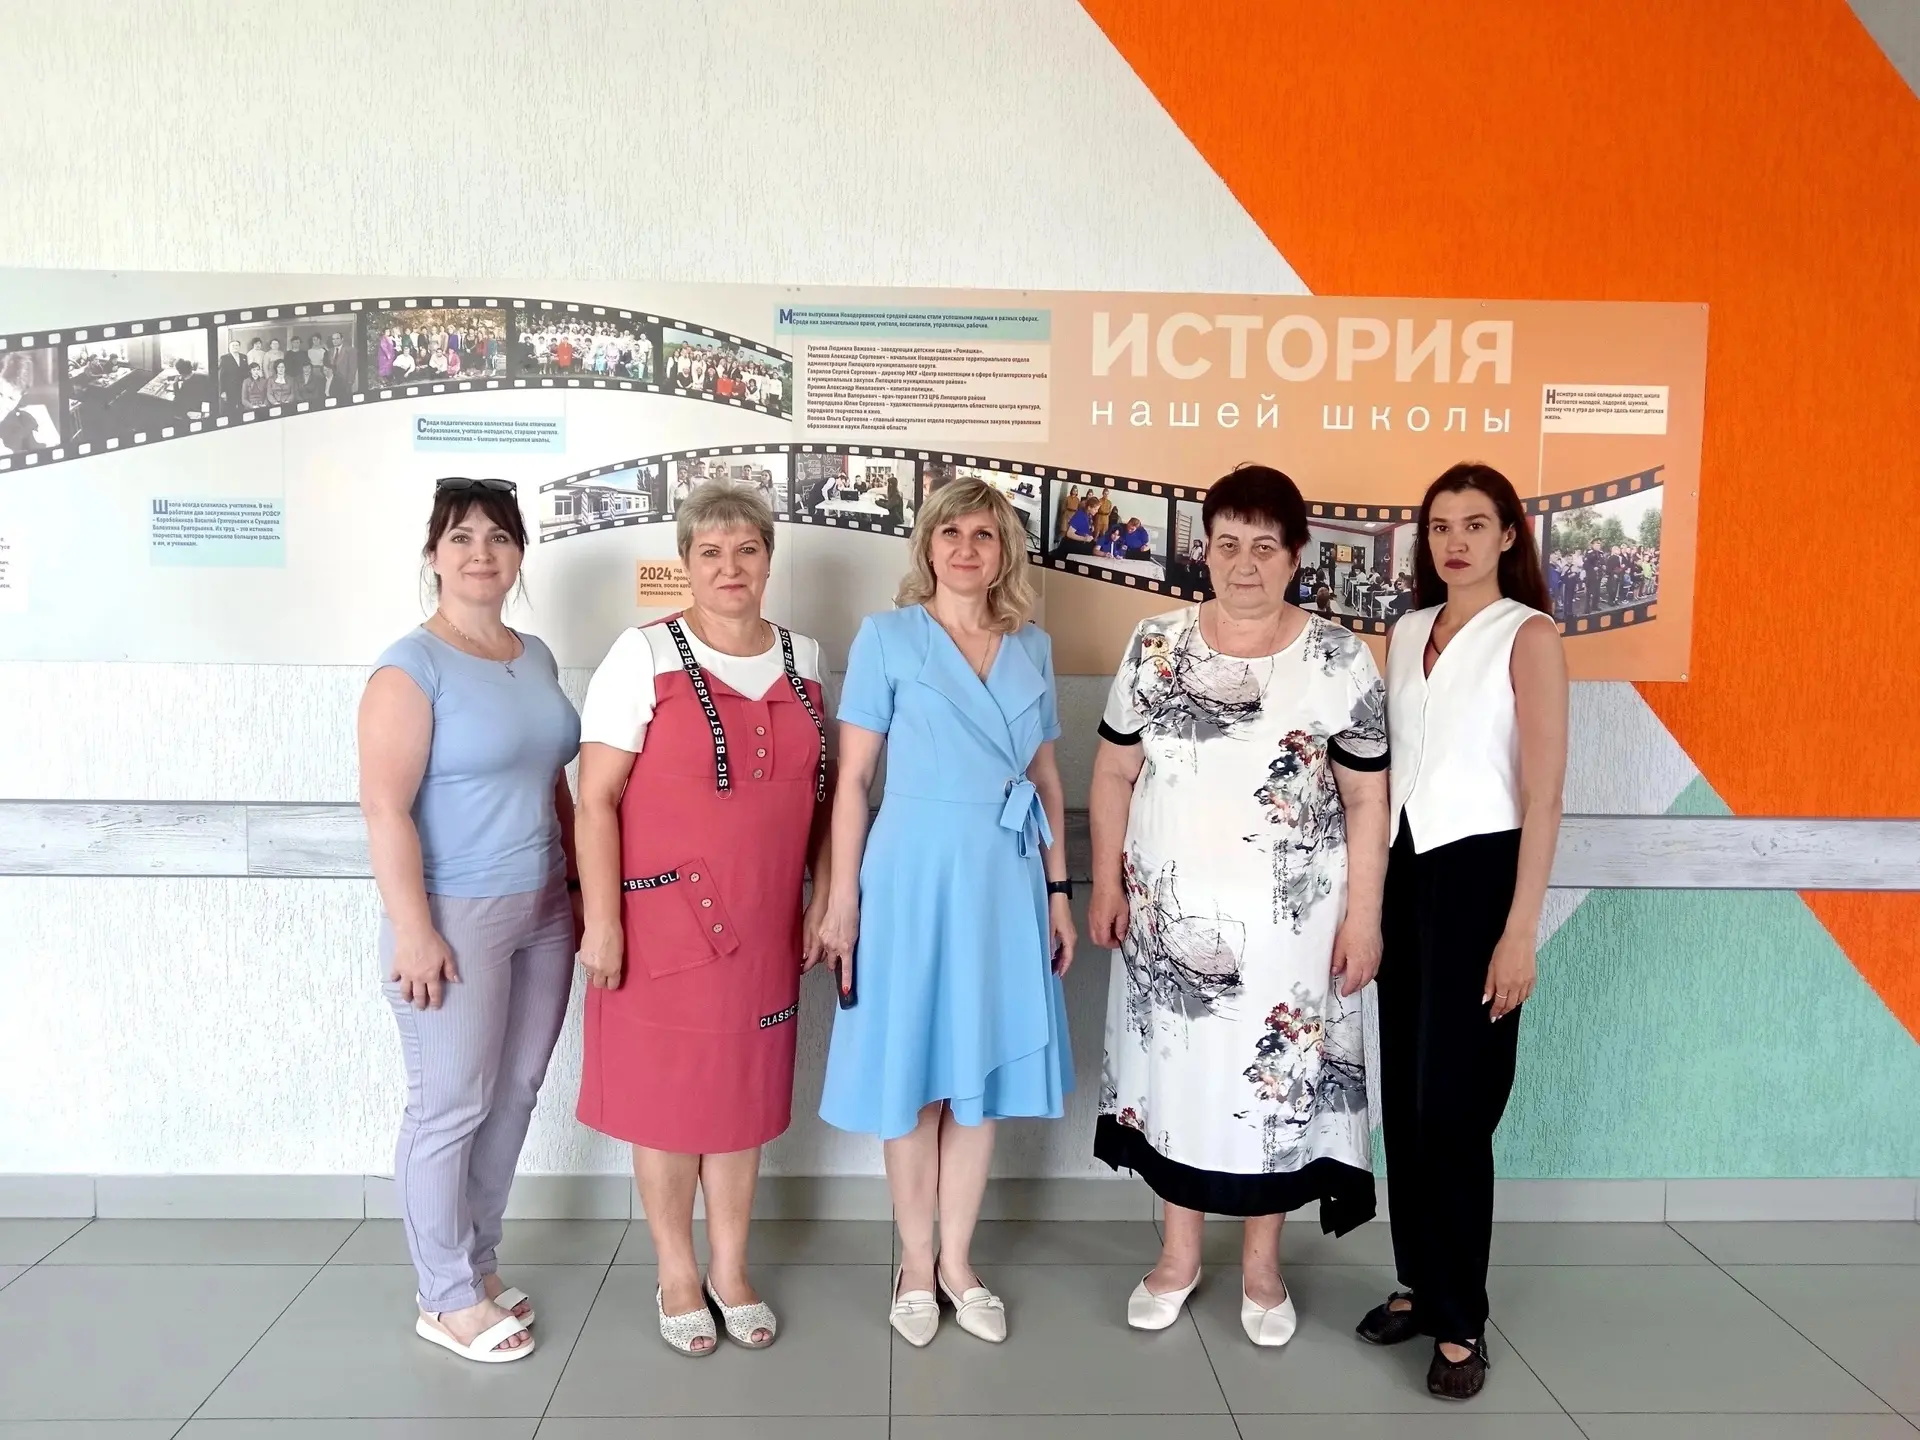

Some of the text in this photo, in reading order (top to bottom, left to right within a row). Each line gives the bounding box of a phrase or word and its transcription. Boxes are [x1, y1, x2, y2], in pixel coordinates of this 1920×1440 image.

[1091, 311, 1514, 385] ИСТОРИЯ
[1091, 393, 1511, 433] нашей школы
[640, 566, 672, 580] 2024
